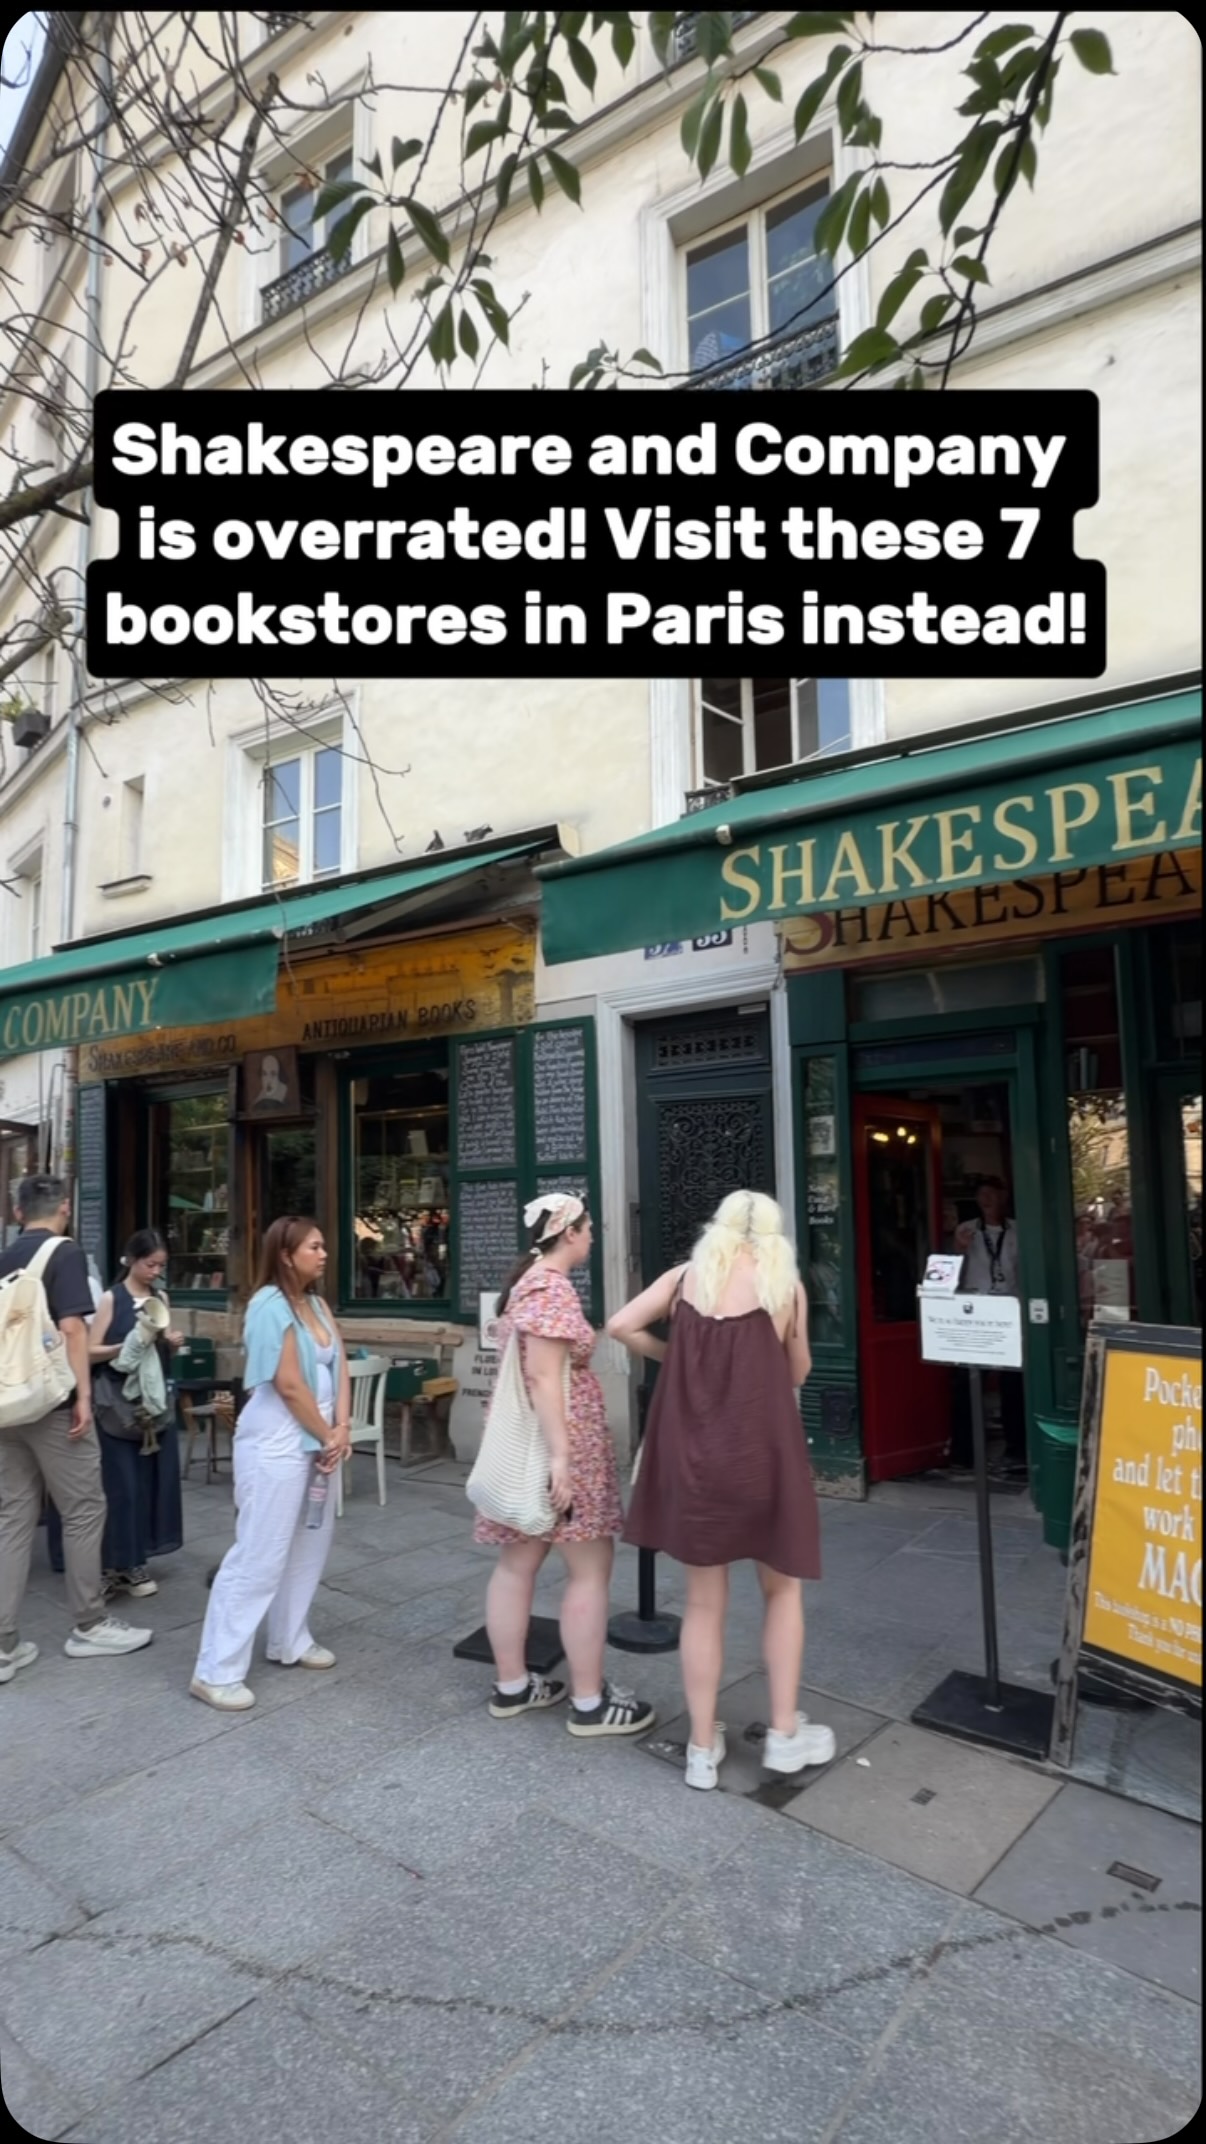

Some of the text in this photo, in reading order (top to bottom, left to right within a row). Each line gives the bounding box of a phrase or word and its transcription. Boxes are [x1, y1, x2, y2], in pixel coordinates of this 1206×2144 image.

[3, 978, 158, 1049] COMPANY
[302, 999, 476, 1041] ANTIQUARIAN BOOKS
[1113, 1453, 1150, 1487] and
[1155, 1455, 1184, 1496] let
[1144, 1503, 1195, 1542] work
